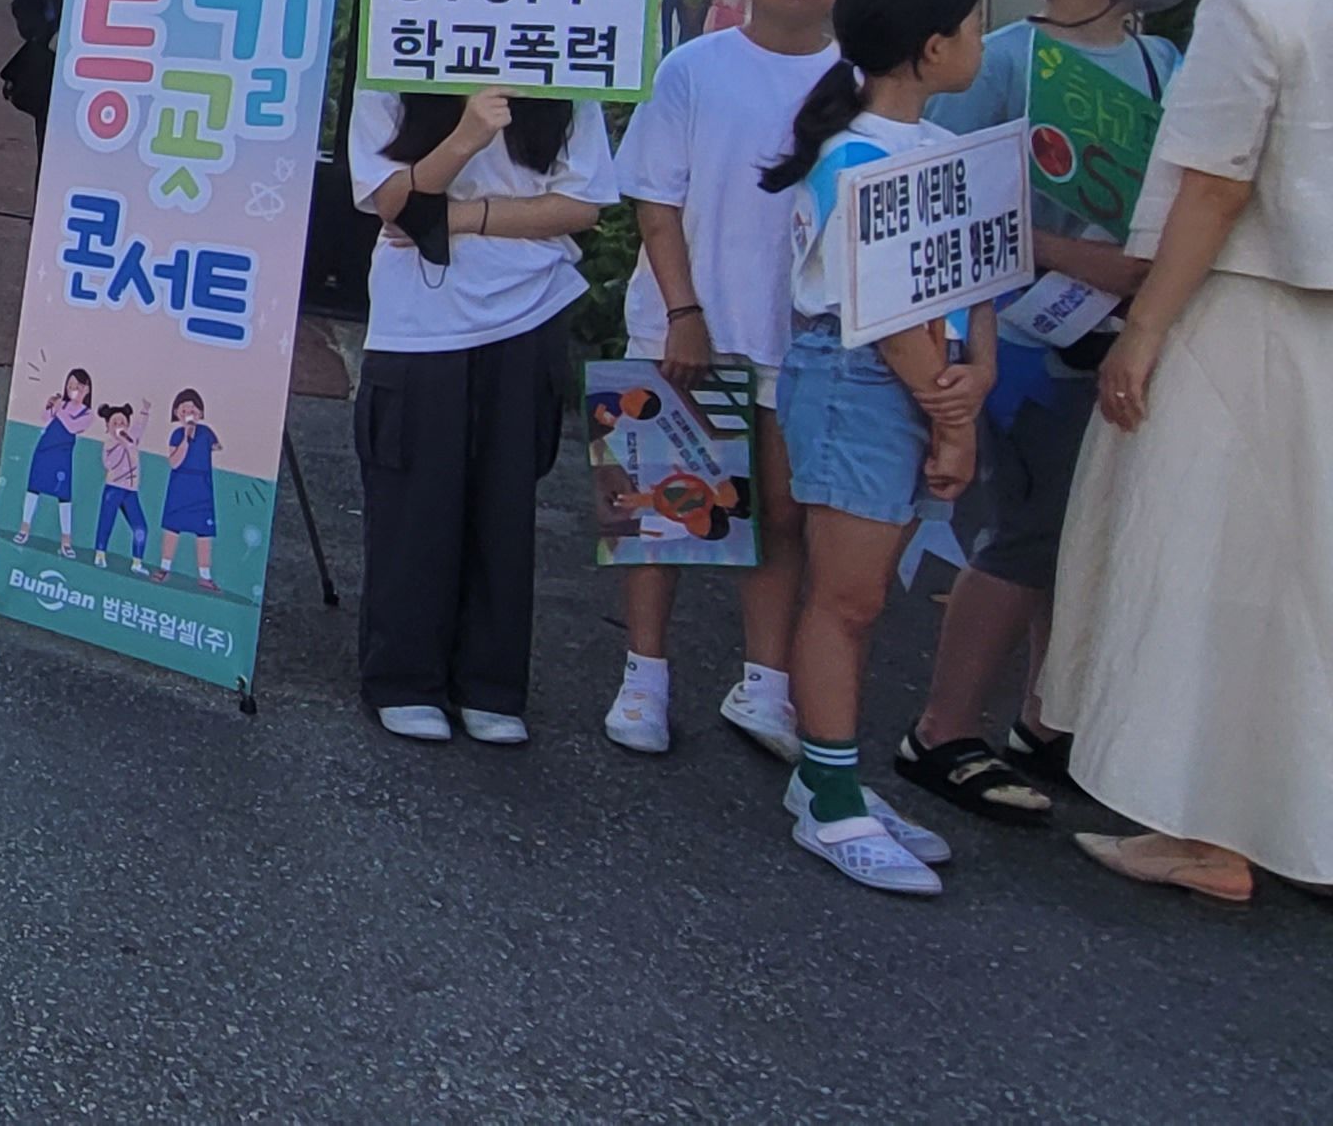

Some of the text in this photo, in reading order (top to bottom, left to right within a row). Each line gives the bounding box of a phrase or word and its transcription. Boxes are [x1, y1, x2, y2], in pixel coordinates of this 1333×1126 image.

[391, 18, 617, 88] 학교폭력
[63, 194, 251, 341] 콘서트
[8, 568, 234, 657] Bumhan 범한퓨얼셀(주)
